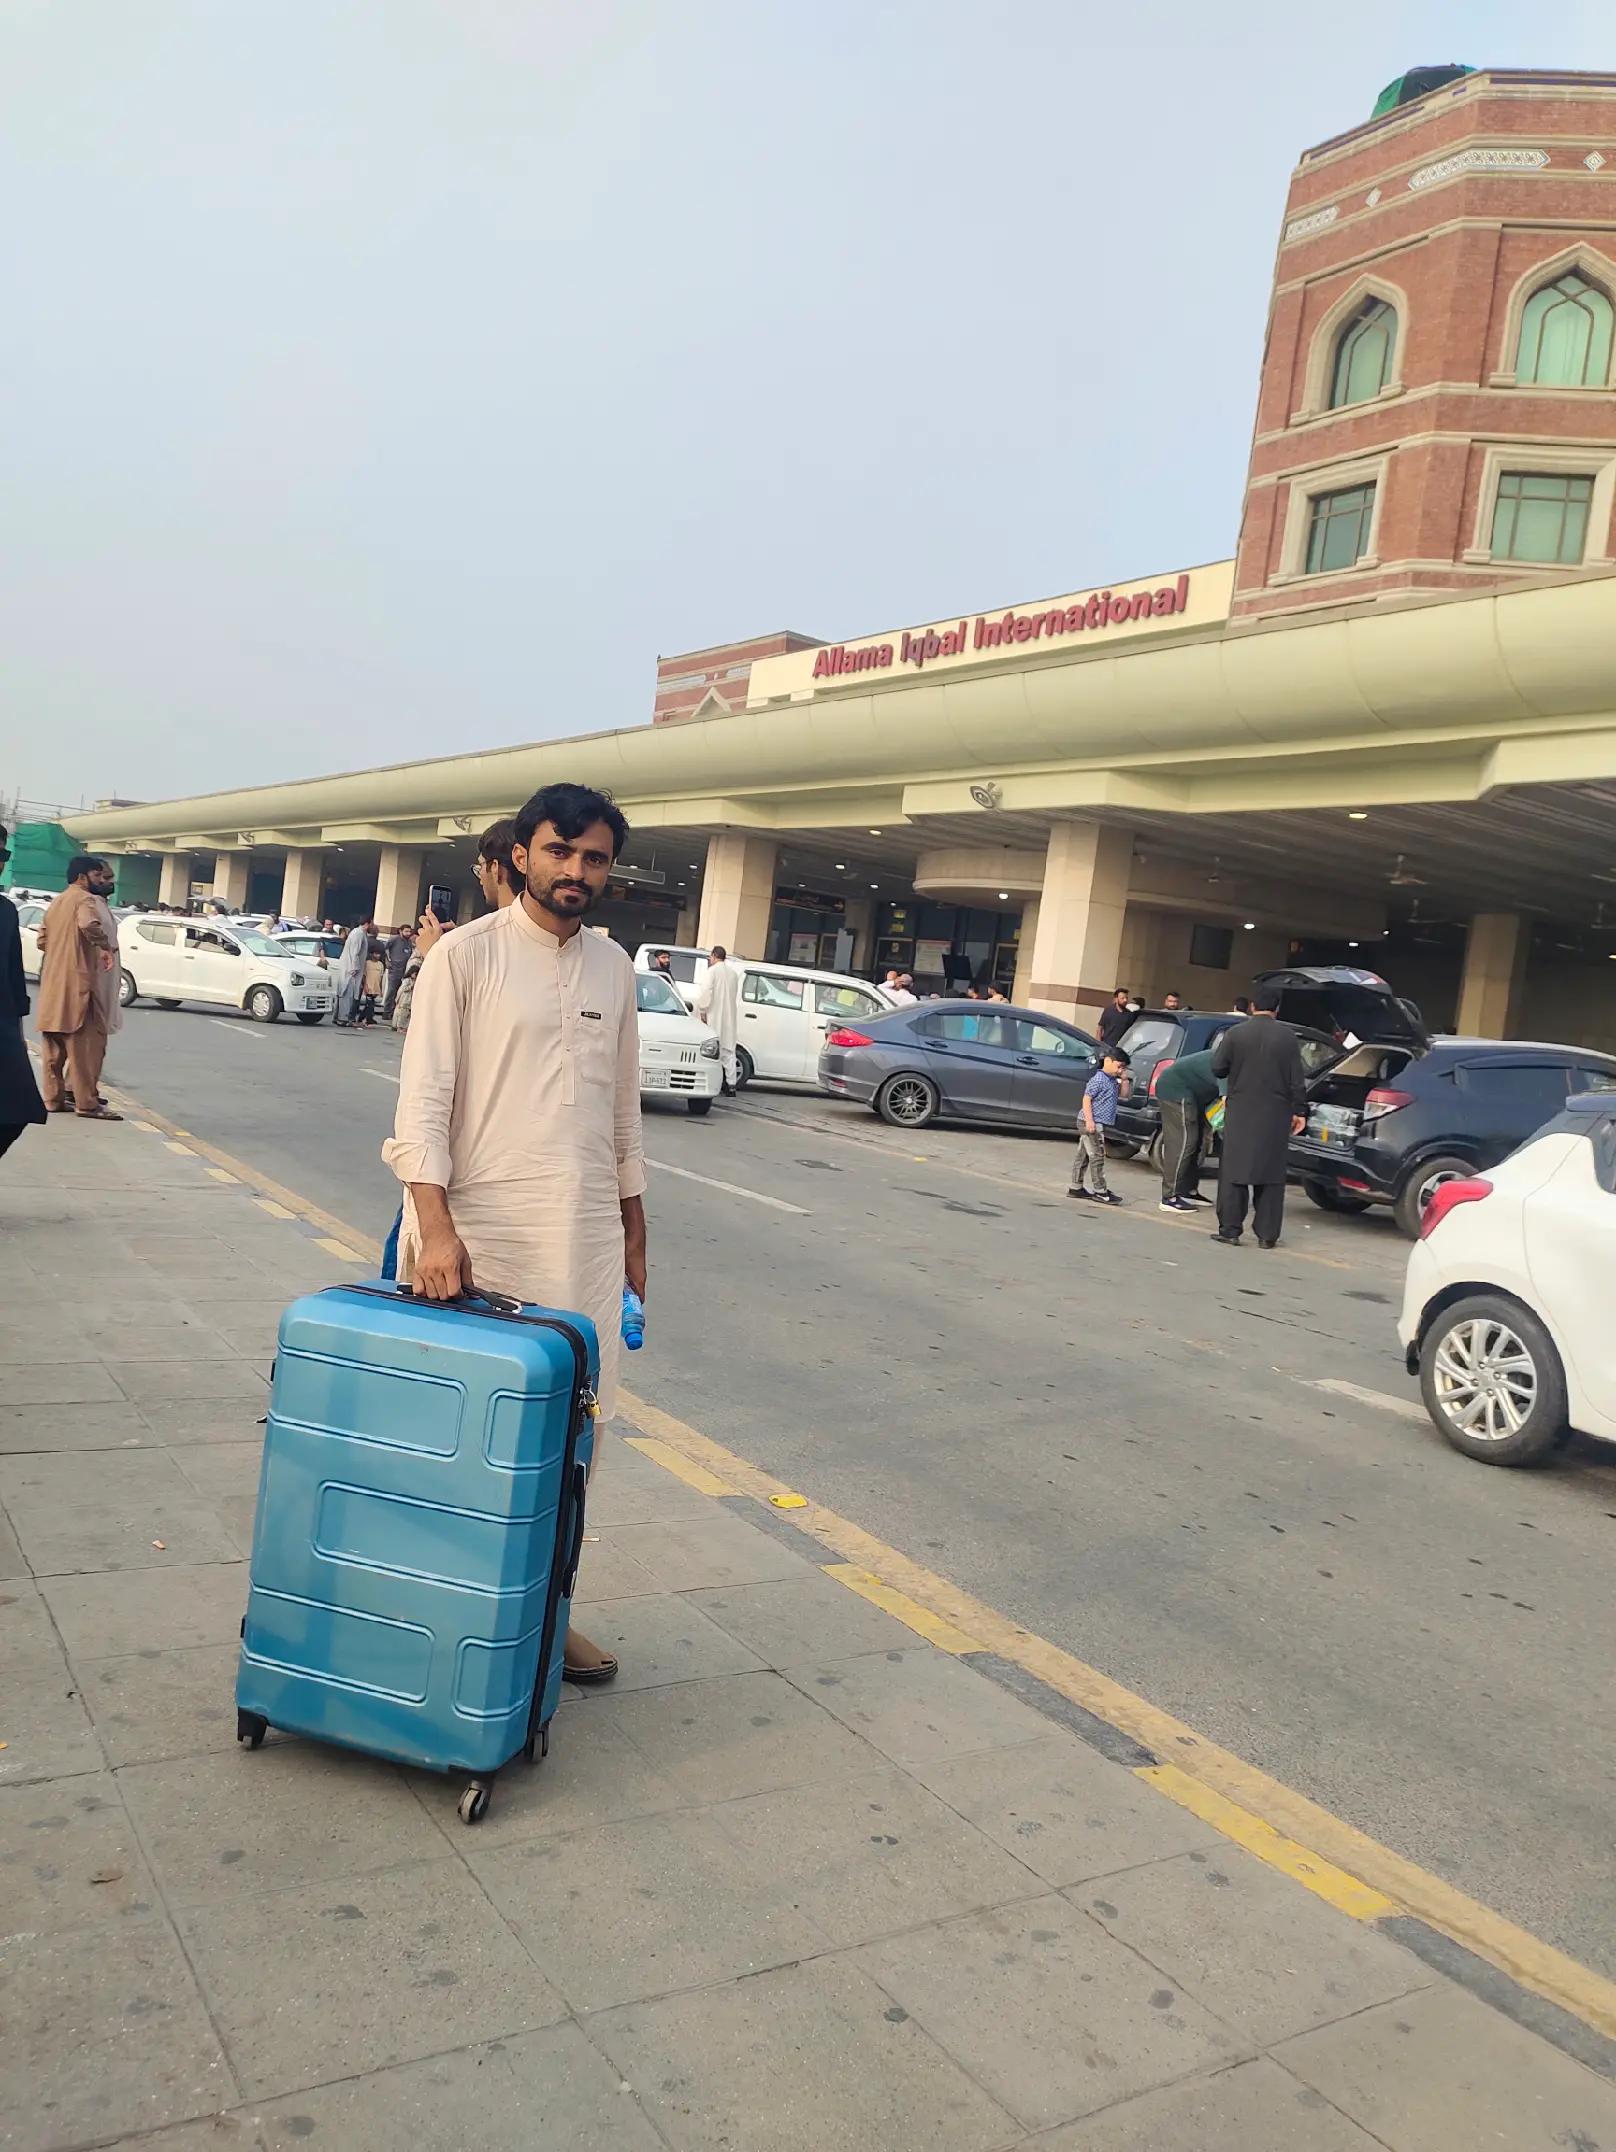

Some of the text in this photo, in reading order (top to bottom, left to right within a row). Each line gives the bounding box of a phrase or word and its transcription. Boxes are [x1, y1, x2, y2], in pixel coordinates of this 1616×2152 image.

[812, 574, 1190, 679] Allama Iqbal International
